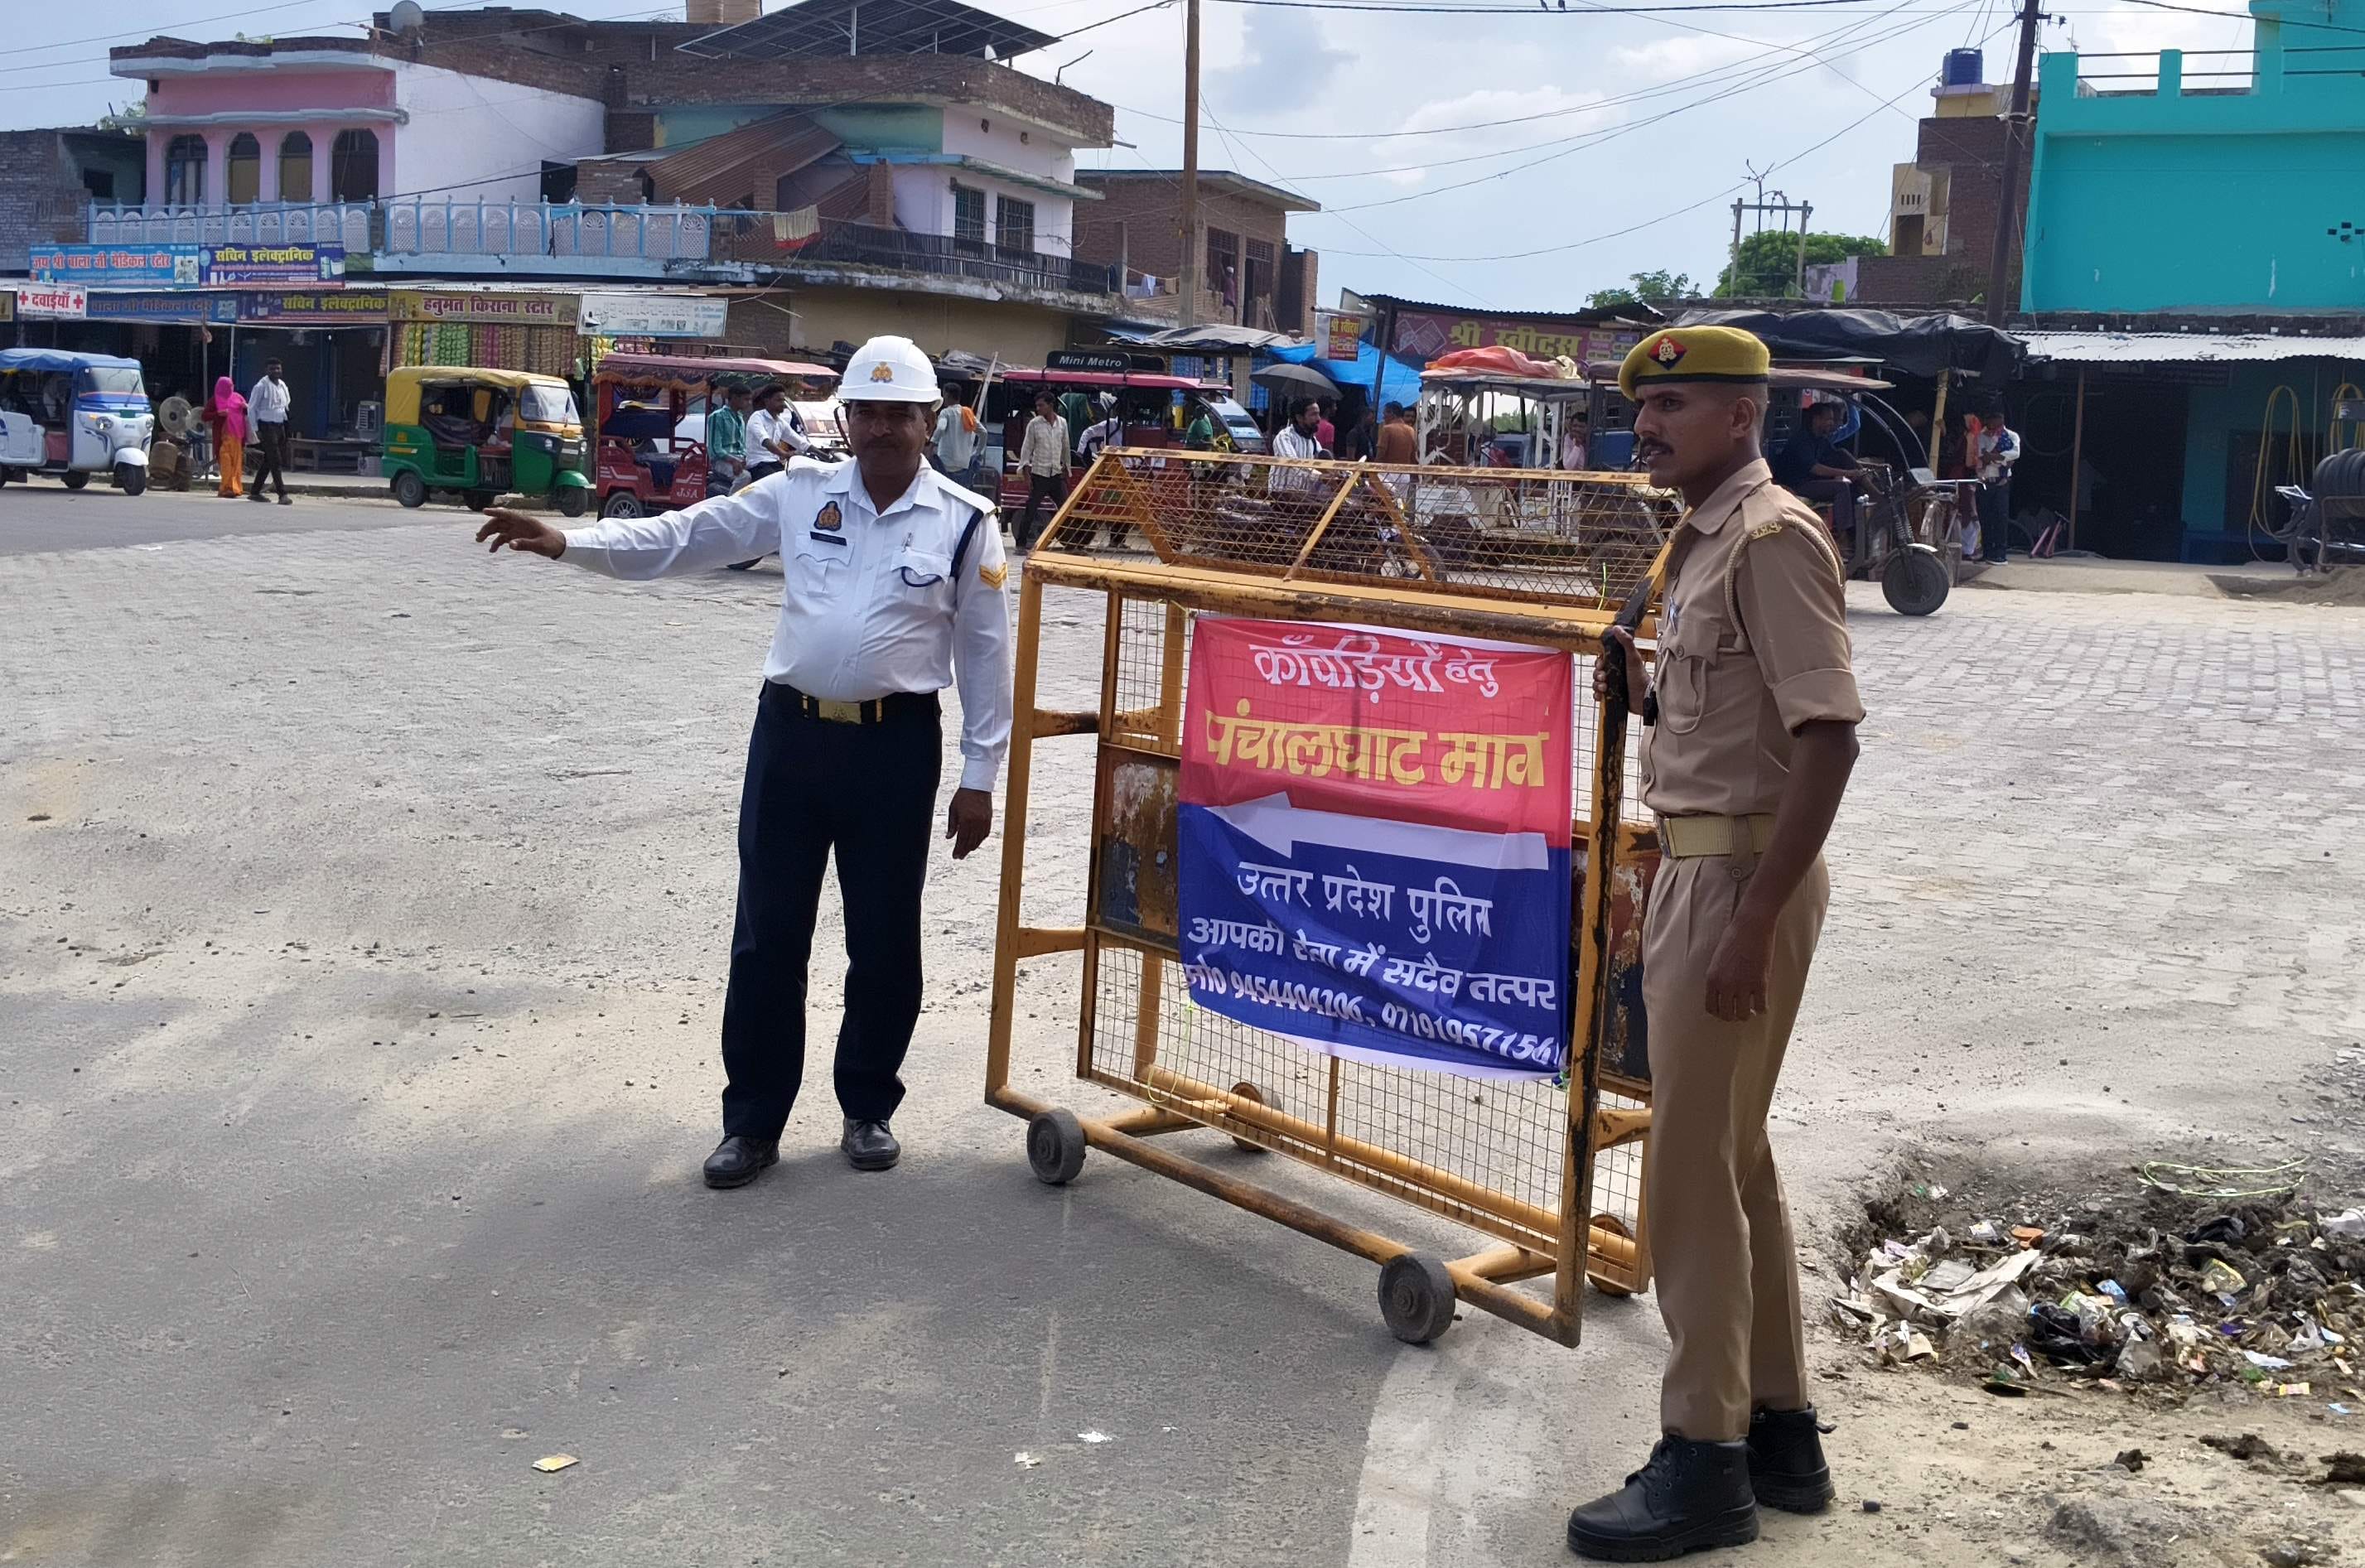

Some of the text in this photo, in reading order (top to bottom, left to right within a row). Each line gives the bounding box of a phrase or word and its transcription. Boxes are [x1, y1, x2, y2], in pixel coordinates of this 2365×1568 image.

[111, 251, 147, 268] मेडिकल
[150, 251, 172, 268] स्टोर
[215, 248, 247, 263] सचिन
[282, 295, 316, 310] सचिन
[423, 295, 555, 316] हनुमत किराना स्टोर
[1448, 321, 1484, 347] श्री
[1059, 355, 1122, 367] Mini Metro
[1445, 649, 1500, 698] हेतु
[1204, 698, 1428, 786] पंचालघाट
[1238, 861, 1314, 908] उत्तर
[1322, 864, 1396, 921] प्रदेश
[1343, 941, 1387, 977] में
[1383, 951, 1465, 998] सदैव
[1465, 972, 1557, 1011] तत्पर
